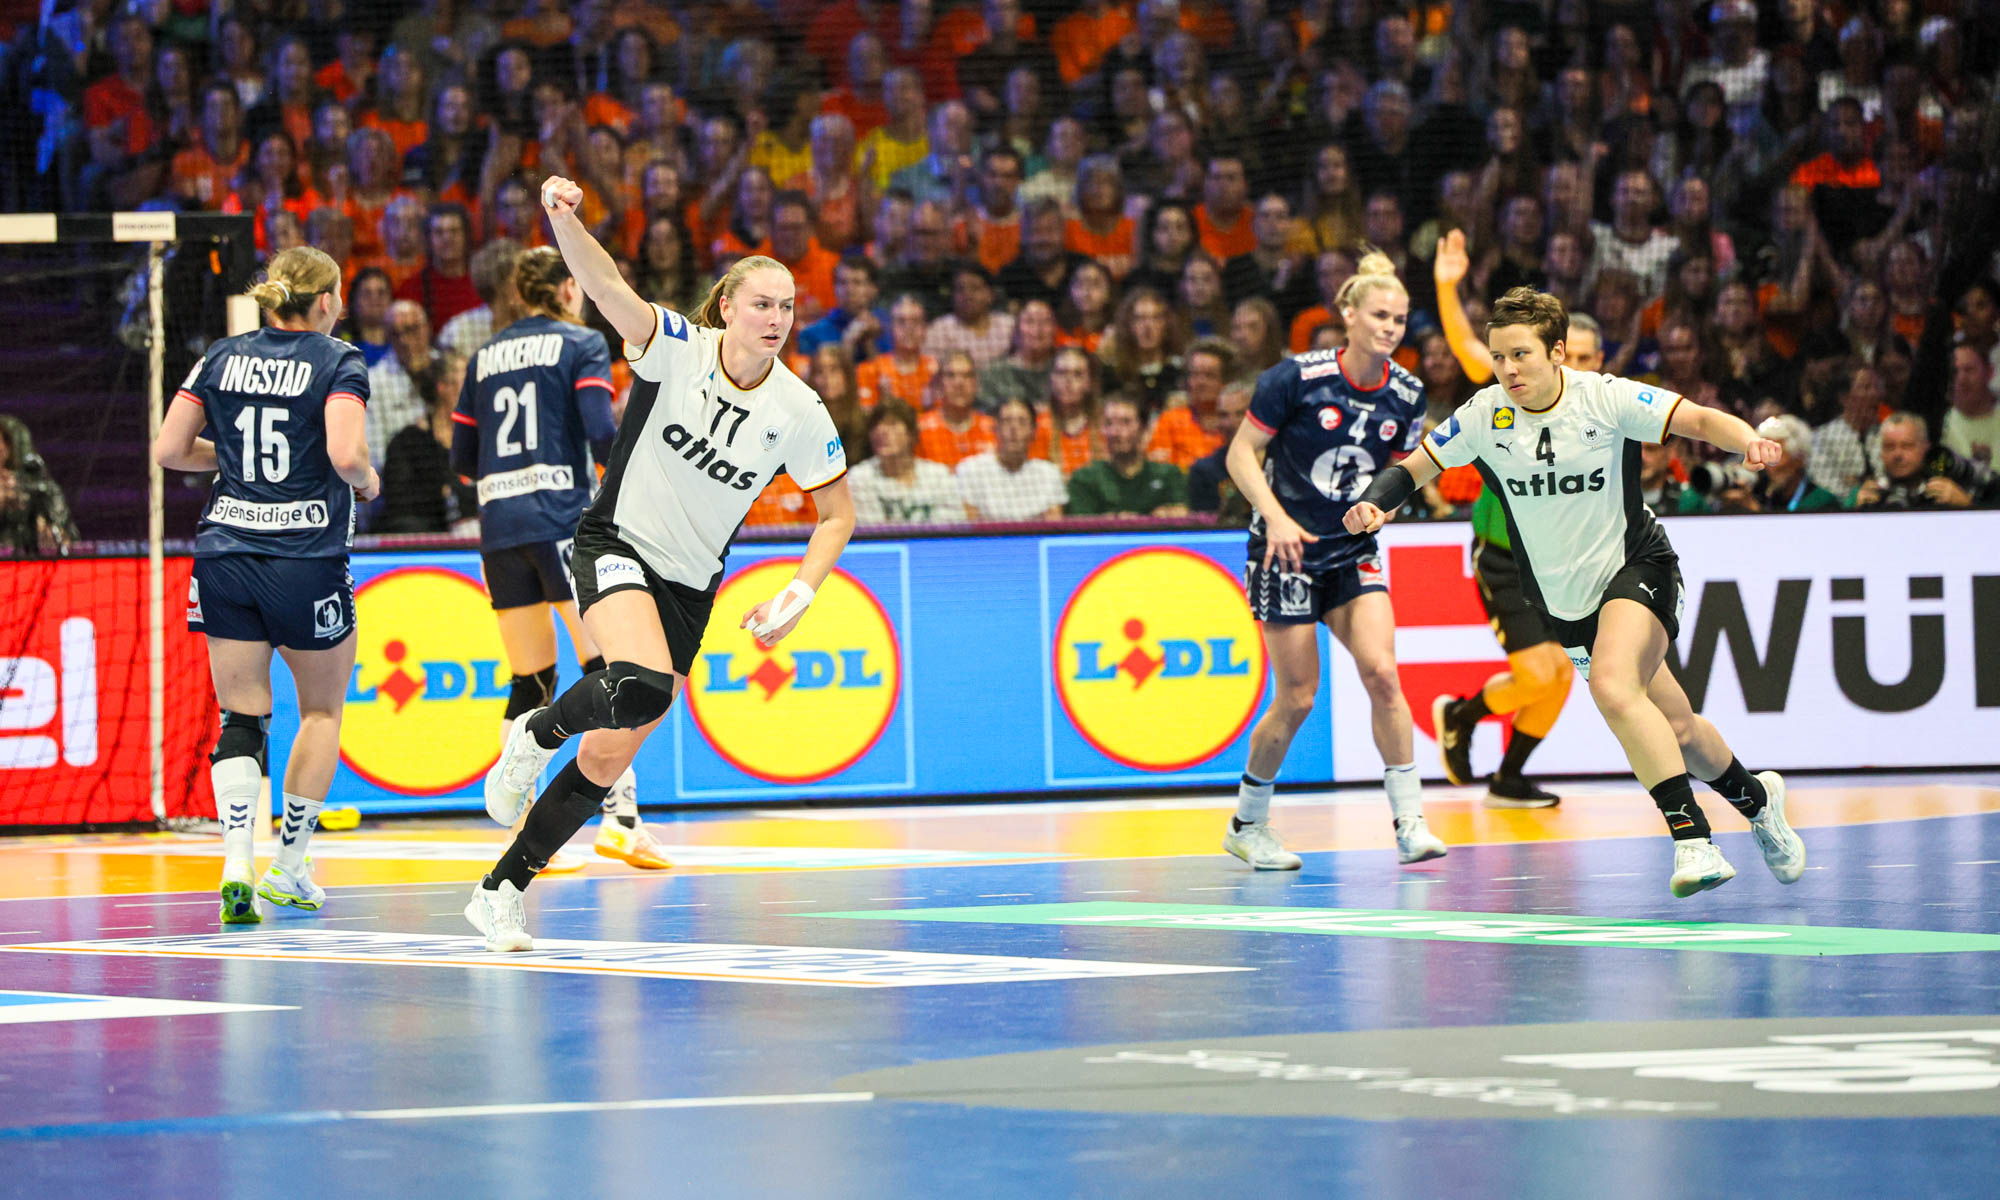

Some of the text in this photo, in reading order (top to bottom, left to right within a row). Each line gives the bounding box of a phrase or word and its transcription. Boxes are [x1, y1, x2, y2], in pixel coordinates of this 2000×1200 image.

[219, 355, 312, 397] INGSTAD
[493, 381, 538, 458] 21
[709, 396, 750, 448] 77
[1348, 410, 1369, 446] 4
[234, 405, 290, 483] 15
[662, 423, 757, 491] atlas
[1536, 427, 1556, 467] 4
[1507, 467, 1606, 497] atlas
[213, 497, 302, 527] Gjensidige
[1666, 574, 2000, 714] WÜ
